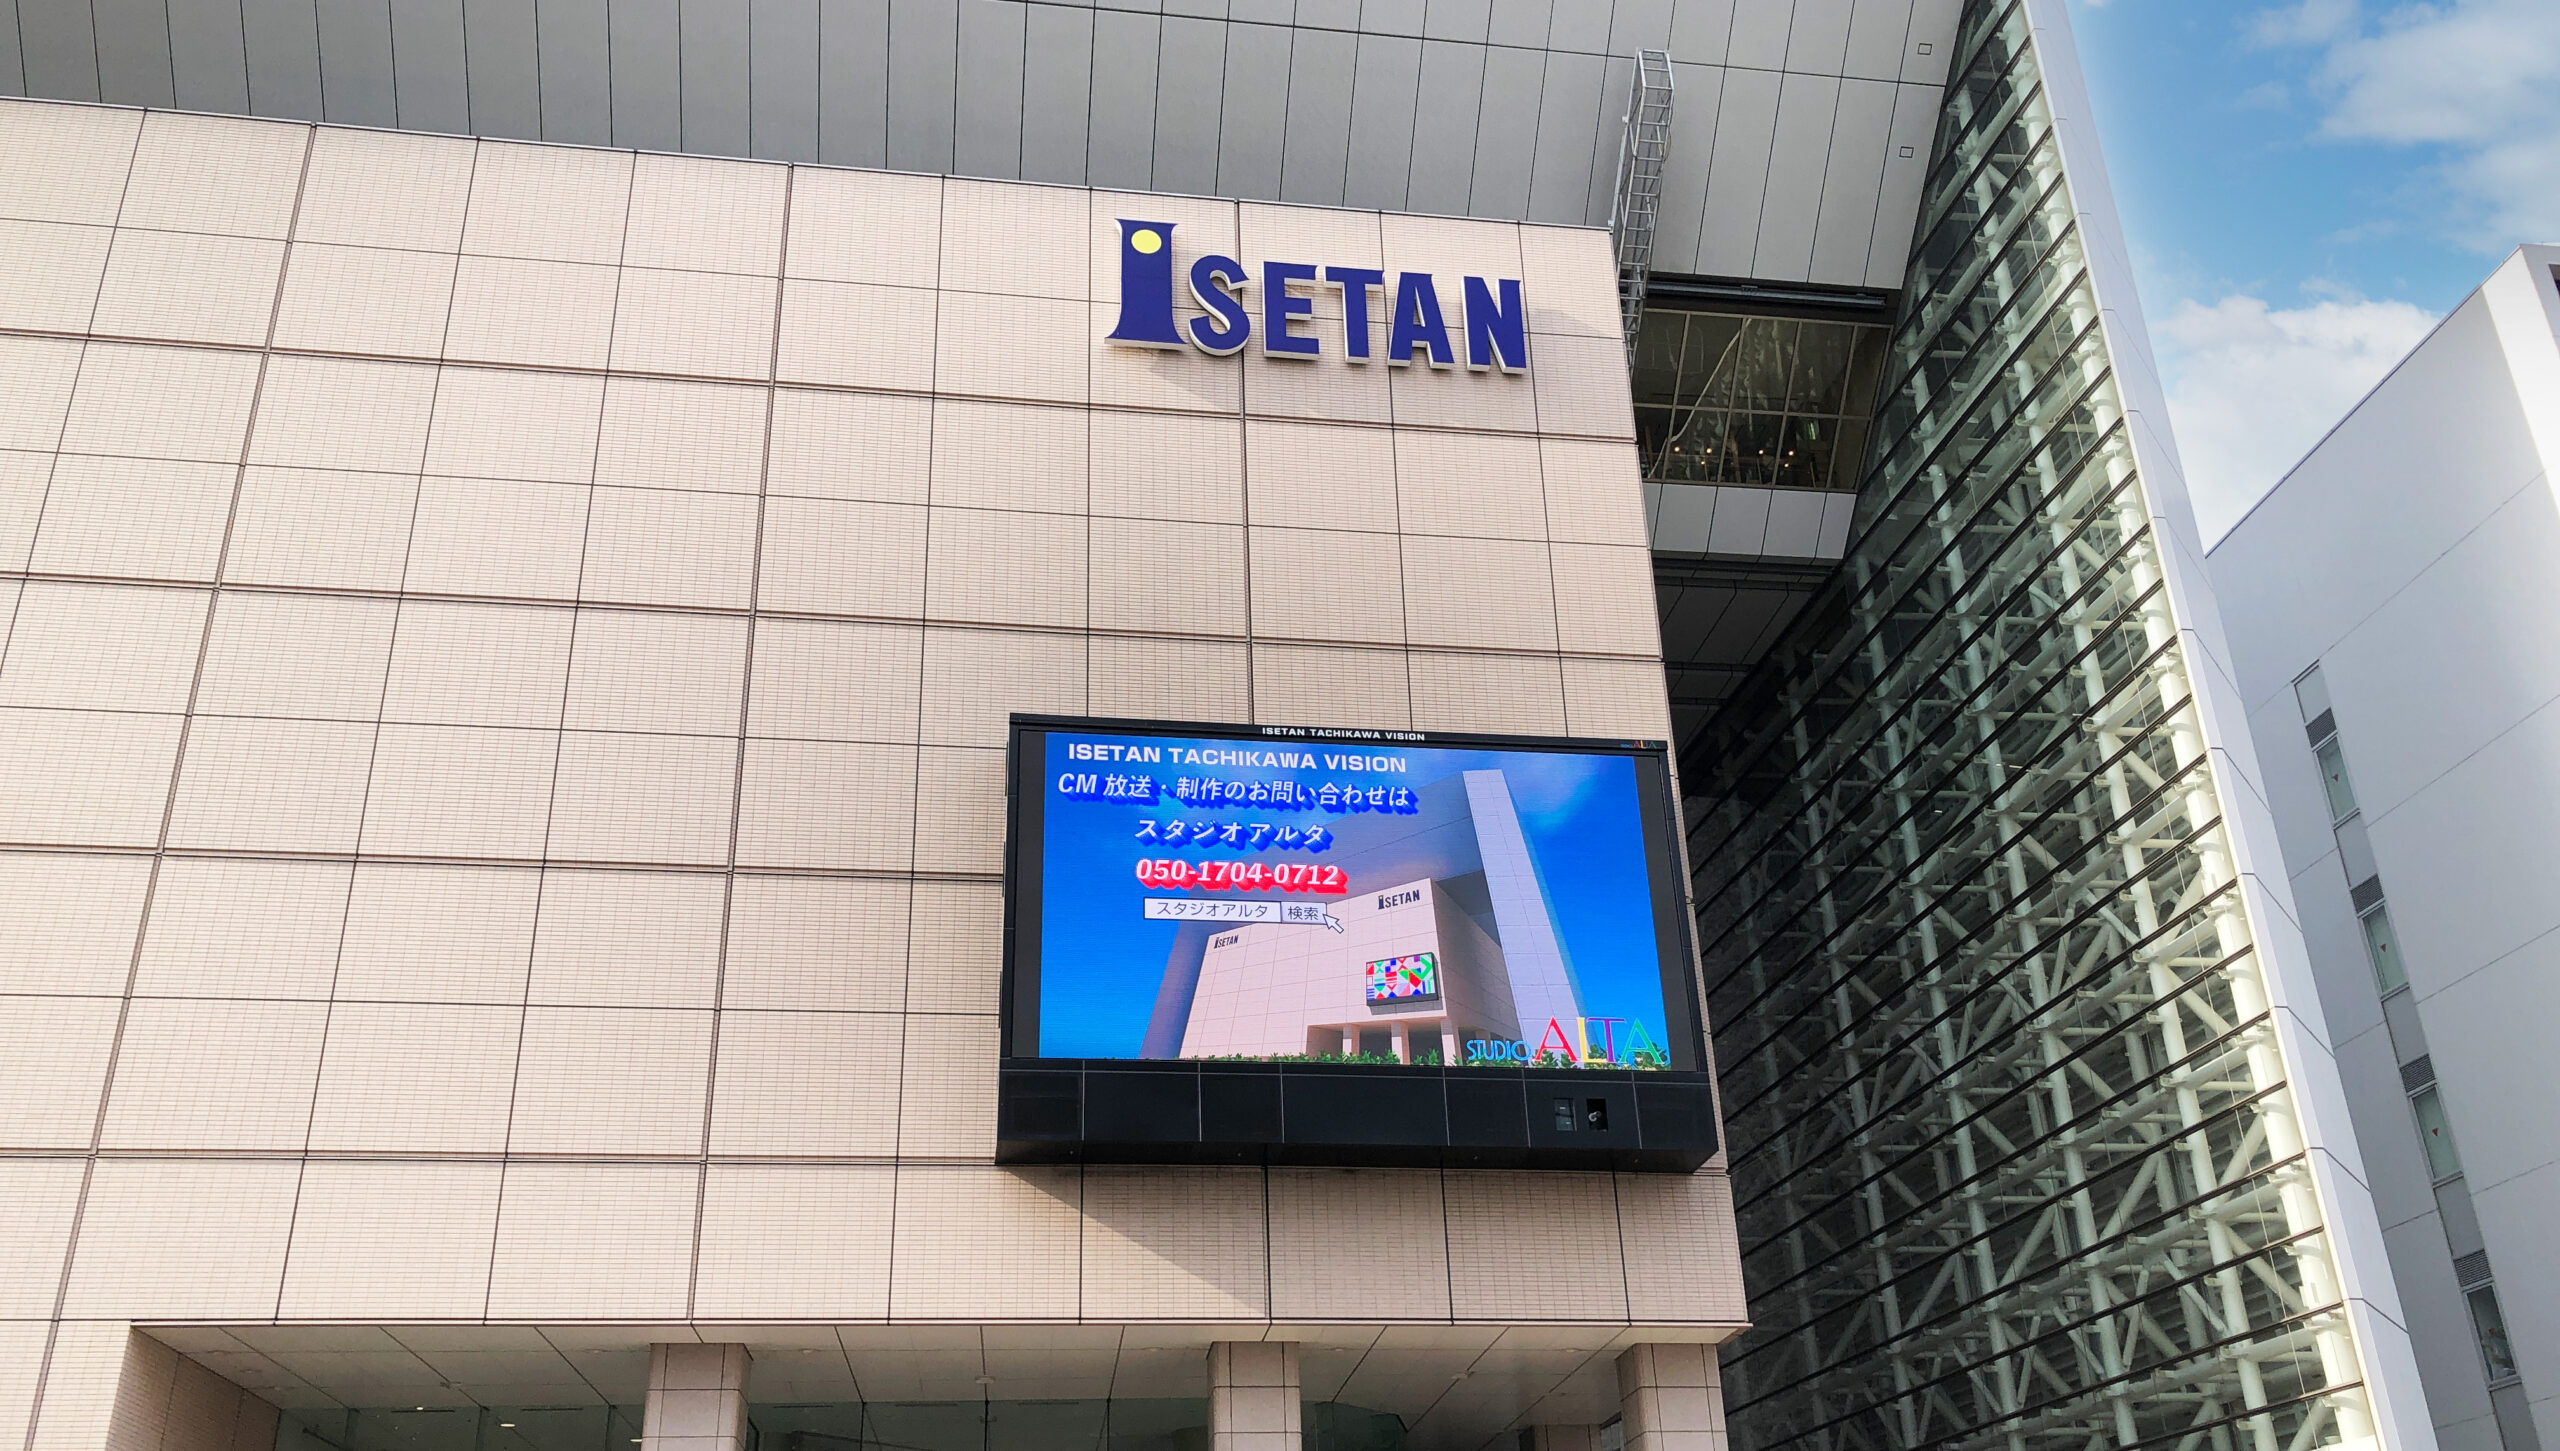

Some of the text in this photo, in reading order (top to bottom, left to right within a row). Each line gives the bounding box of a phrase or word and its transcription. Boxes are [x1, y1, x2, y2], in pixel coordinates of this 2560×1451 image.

[1262, 727, 1425, 741] ISETAN TACHIKAWA VISION
[1068, 743, 1406, 773] ISETAN TACHIKAWA VISION
[1058, 773, 1098, 794] CM
[1135, 819, 1325, 844] スタジオアルタ
[1136, 858, 1339, 886] 050-1704-0712
[1157, 902, 1319, 920] スタジオアルタ 検索
[1466, 1017, 1665, 1065] STUDIO ALTA
